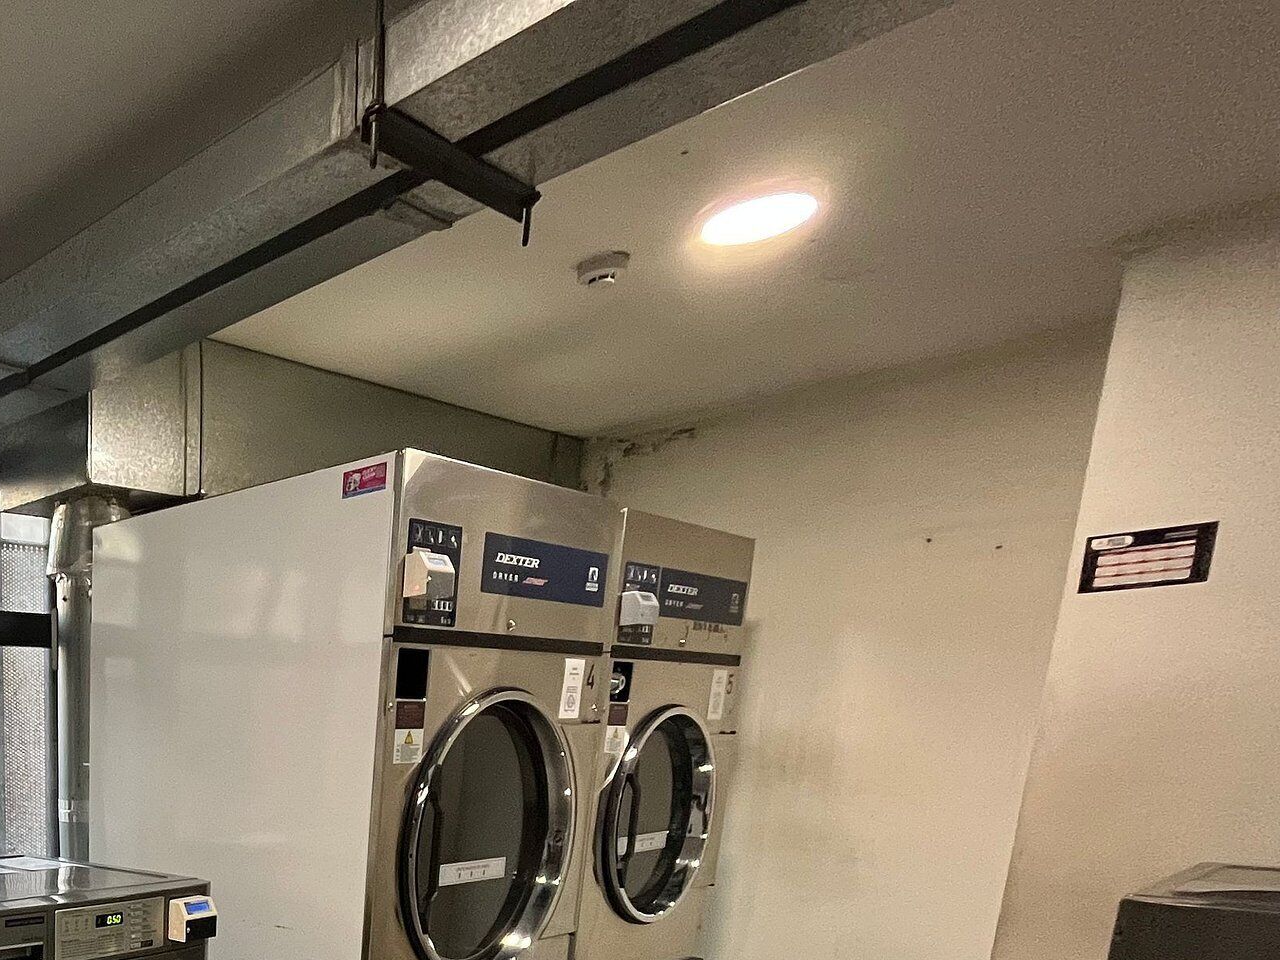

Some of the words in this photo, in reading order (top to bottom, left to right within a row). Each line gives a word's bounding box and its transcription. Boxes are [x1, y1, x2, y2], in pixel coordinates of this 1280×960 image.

[495, 552, 540, 568] DEXTER
[667, 584, 699, 596] DEXTER
[586, 664, 595, 690] 4
[726, 674, 734, 694] 5
